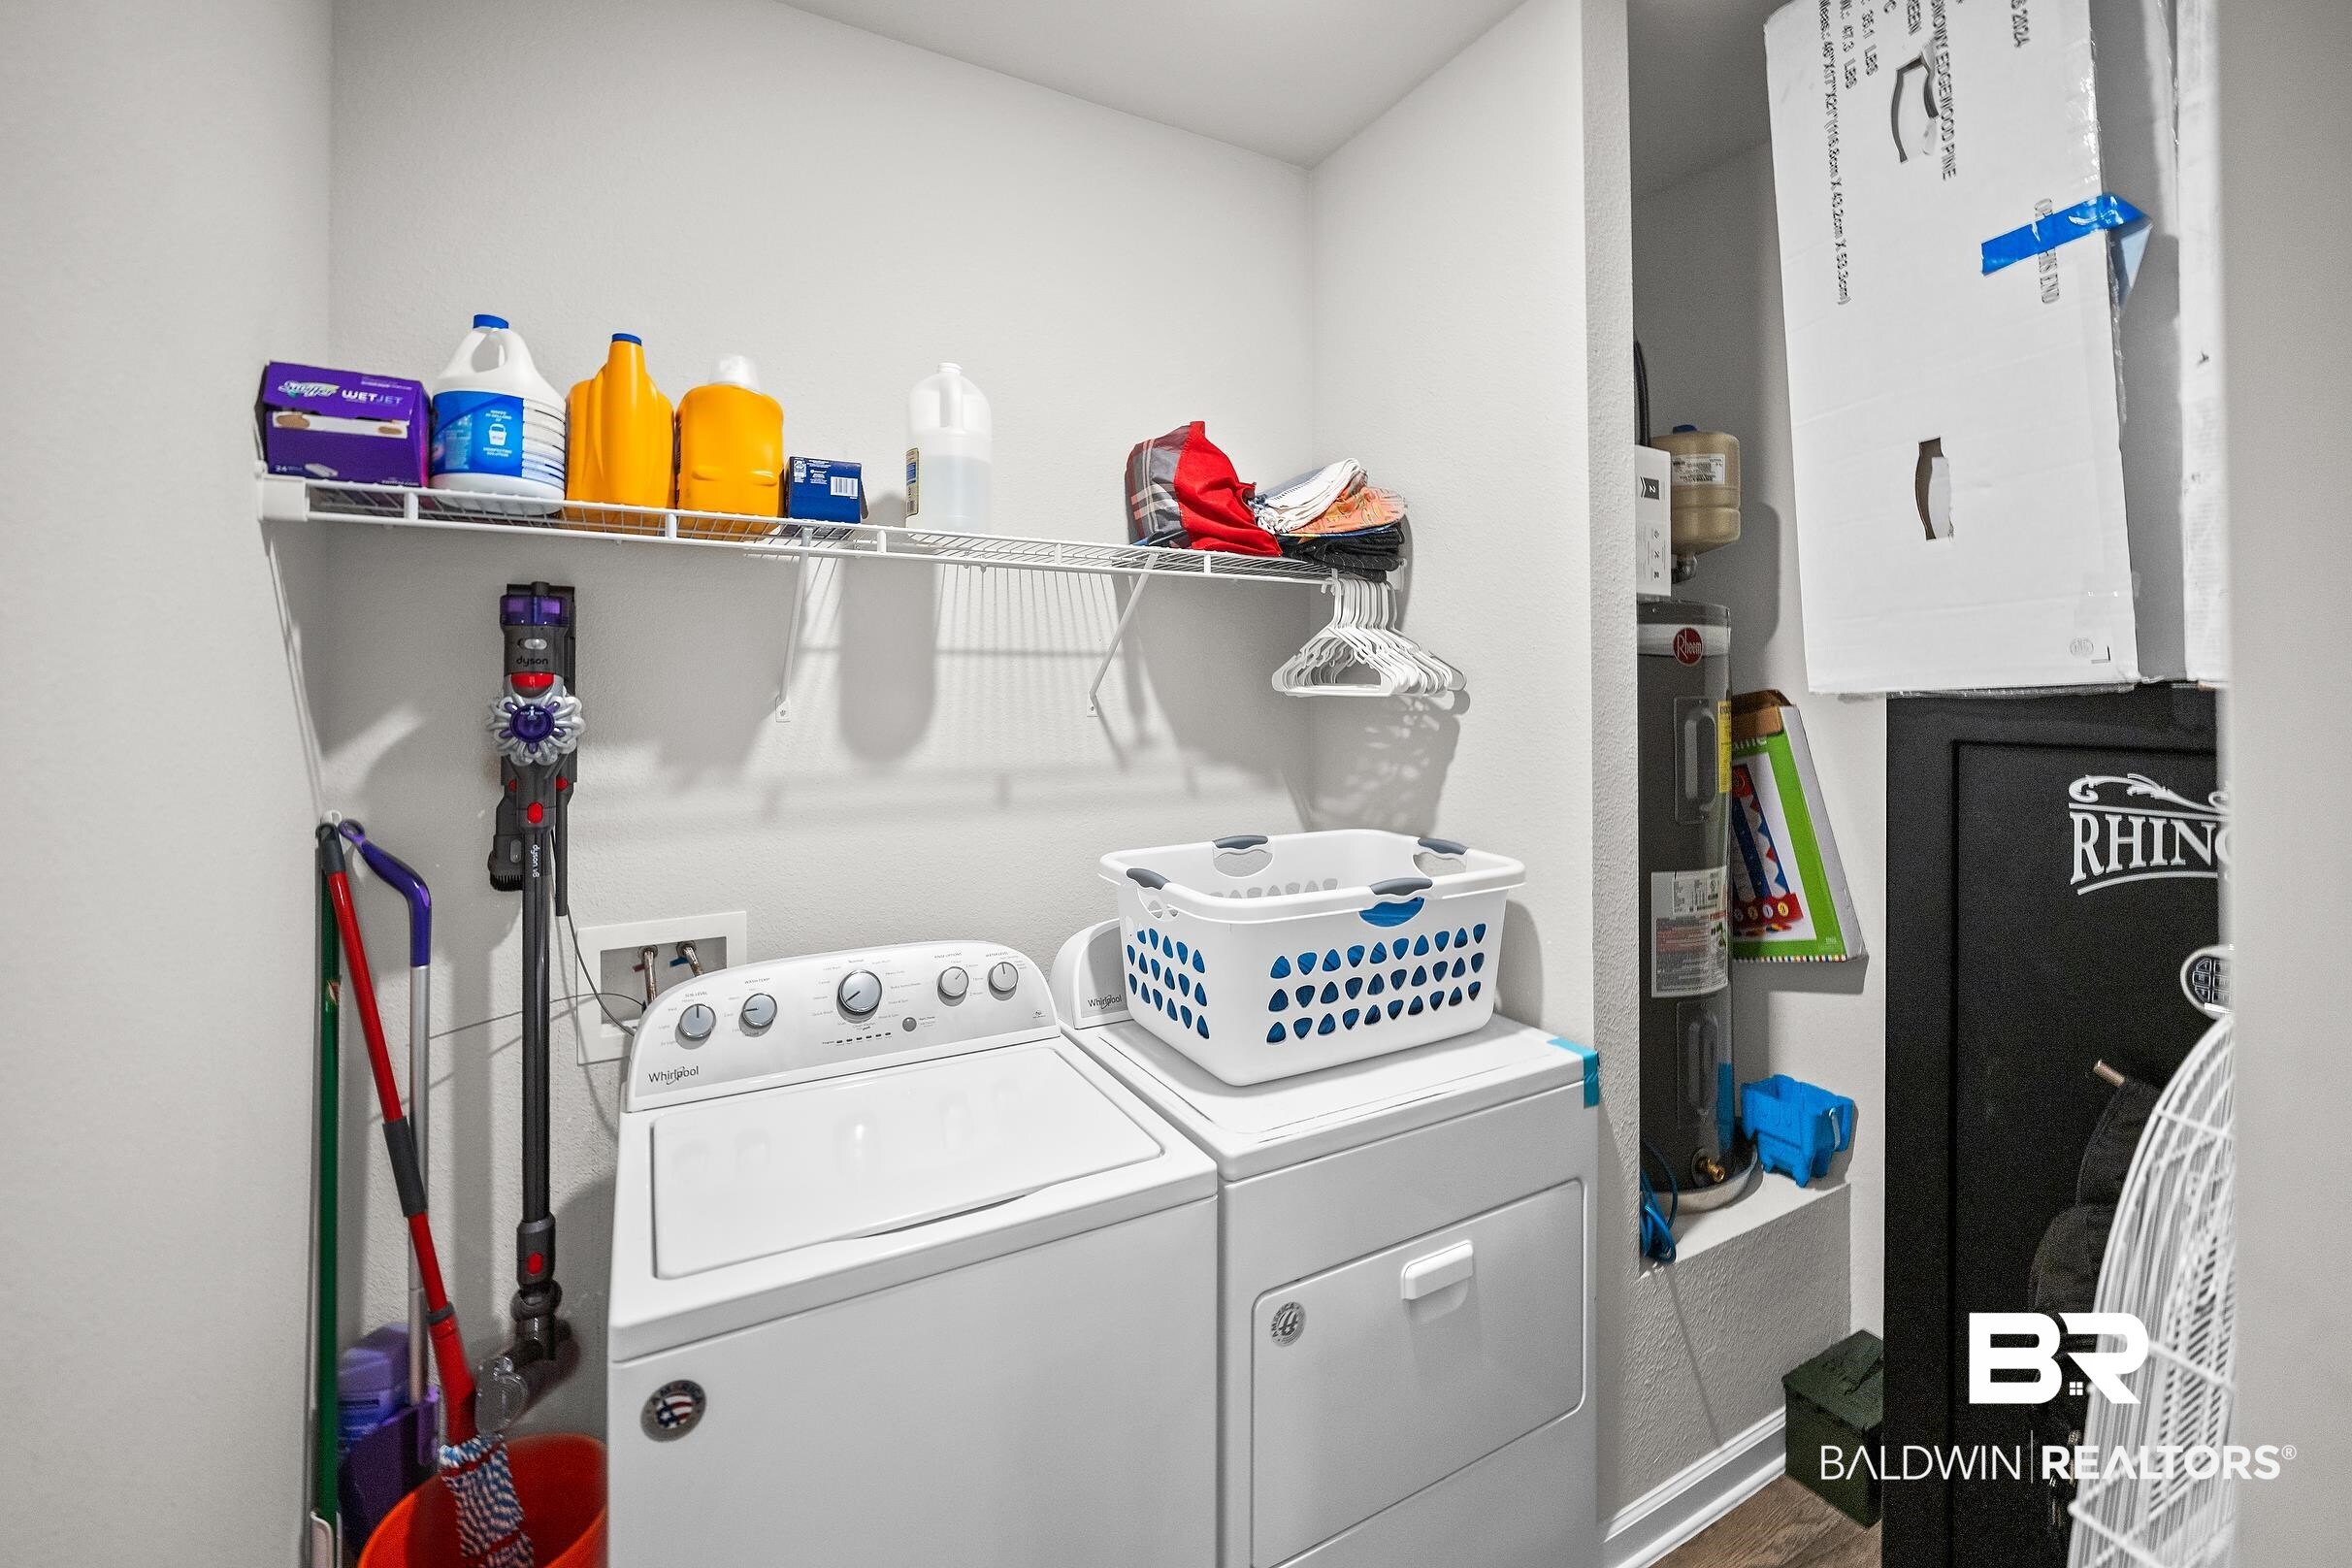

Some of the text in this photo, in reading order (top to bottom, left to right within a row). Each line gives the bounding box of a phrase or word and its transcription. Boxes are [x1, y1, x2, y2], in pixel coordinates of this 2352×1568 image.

[2012, 9, 2030, 49] 2024
[1844, 58, 1857, 90] LBS
[1864, 45, 1878, 76] LBS
[1936, 51, 1954, 142] EDGEWOOD
[1942, 143, 1957, 181] PINE
[1677, 628, 1702, 661] Rheem
[516, 655, 549, 667] dyson
[530, 844, 540, 867] dyson
[1087, 995, 1123, 1009] Whirlpool
[648, 1065, 699, 1085] Whirlpool
